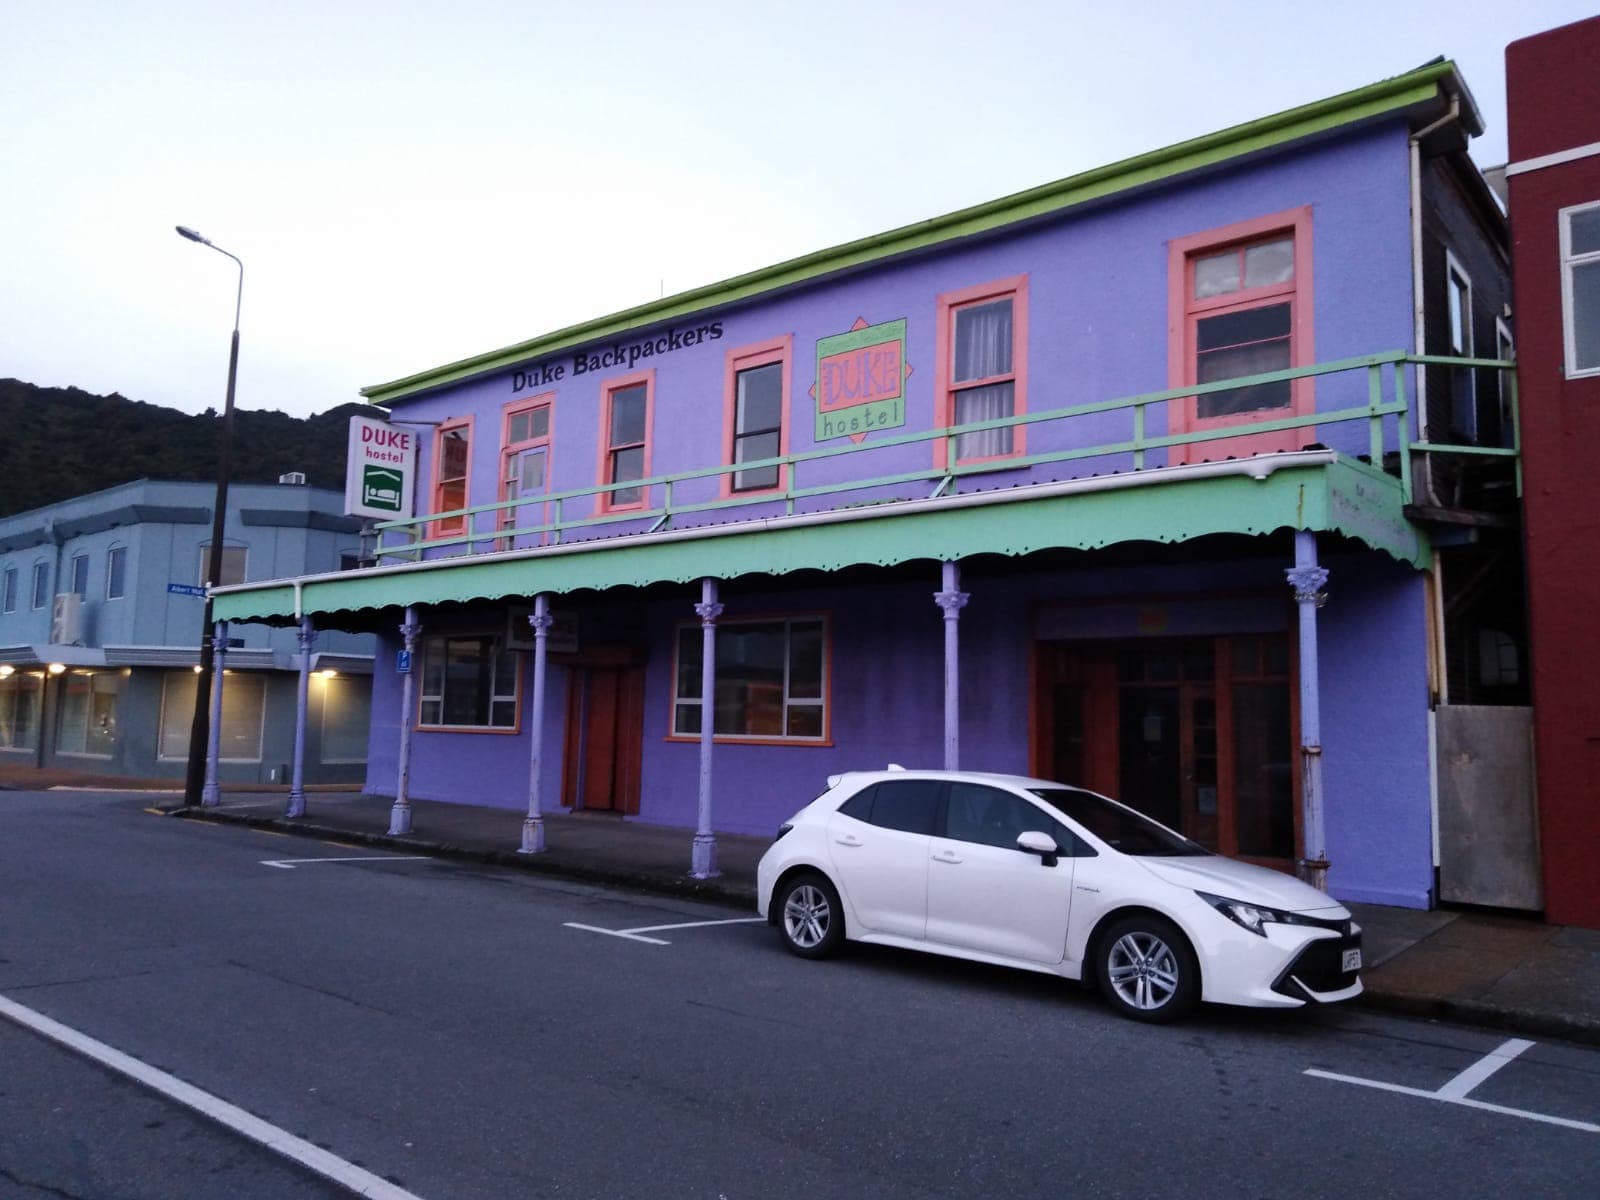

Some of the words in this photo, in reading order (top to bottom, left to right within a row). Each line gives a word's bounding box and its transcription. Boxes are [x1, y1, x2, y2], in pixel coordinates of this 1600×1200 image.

[512, 363, 565, 393] Duke
[572, 322, 723, 376] Backpackers
[823, 351, 898, 405] DUKE
[823, 402, 898, 436] hostel
[362, 425, 409, 450] DUKE
[366, 446, 403, 463] hostel
